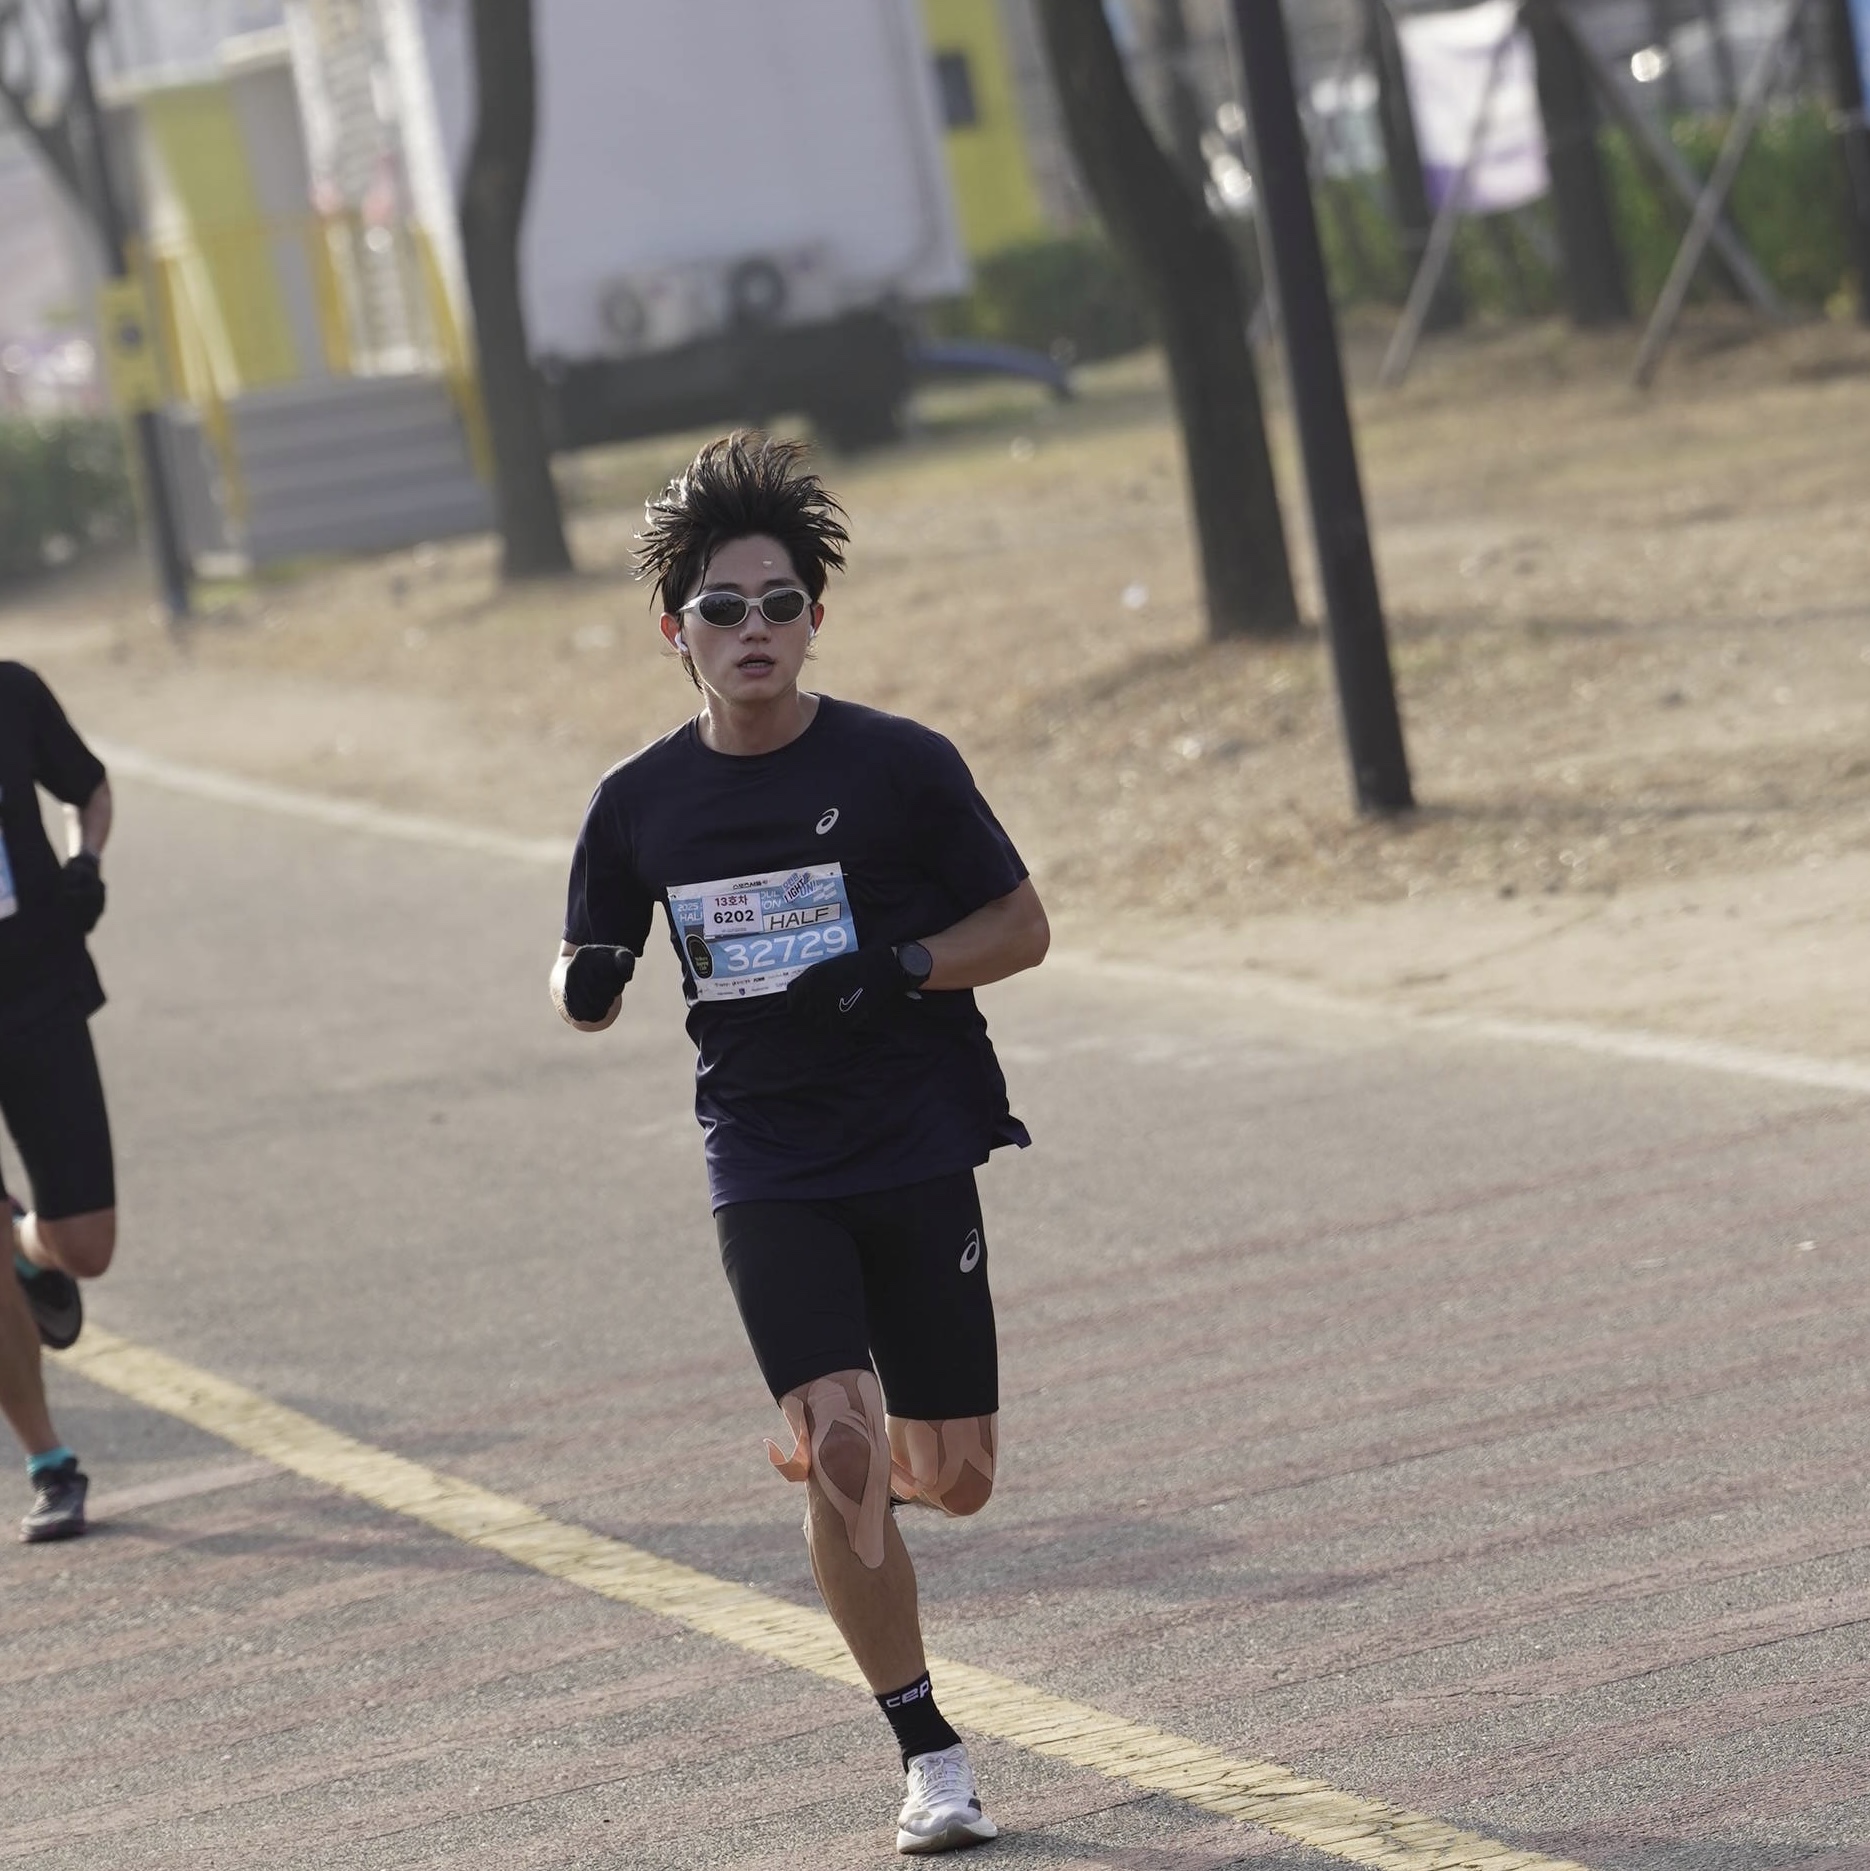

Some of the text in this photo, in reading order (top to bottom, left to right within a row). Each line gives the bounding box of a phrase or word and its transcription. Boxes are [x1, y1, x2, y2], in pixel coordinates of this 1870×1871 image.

[784, 878, 805, 903] LIGHT
[714, 894, 748, 907] 13호차
[680, 911, 703, 922] HAL
[713, 909, 755, 924] 6202
[770, 907, 829, 930] HALF
[724, 926, 848, 972] 32729
